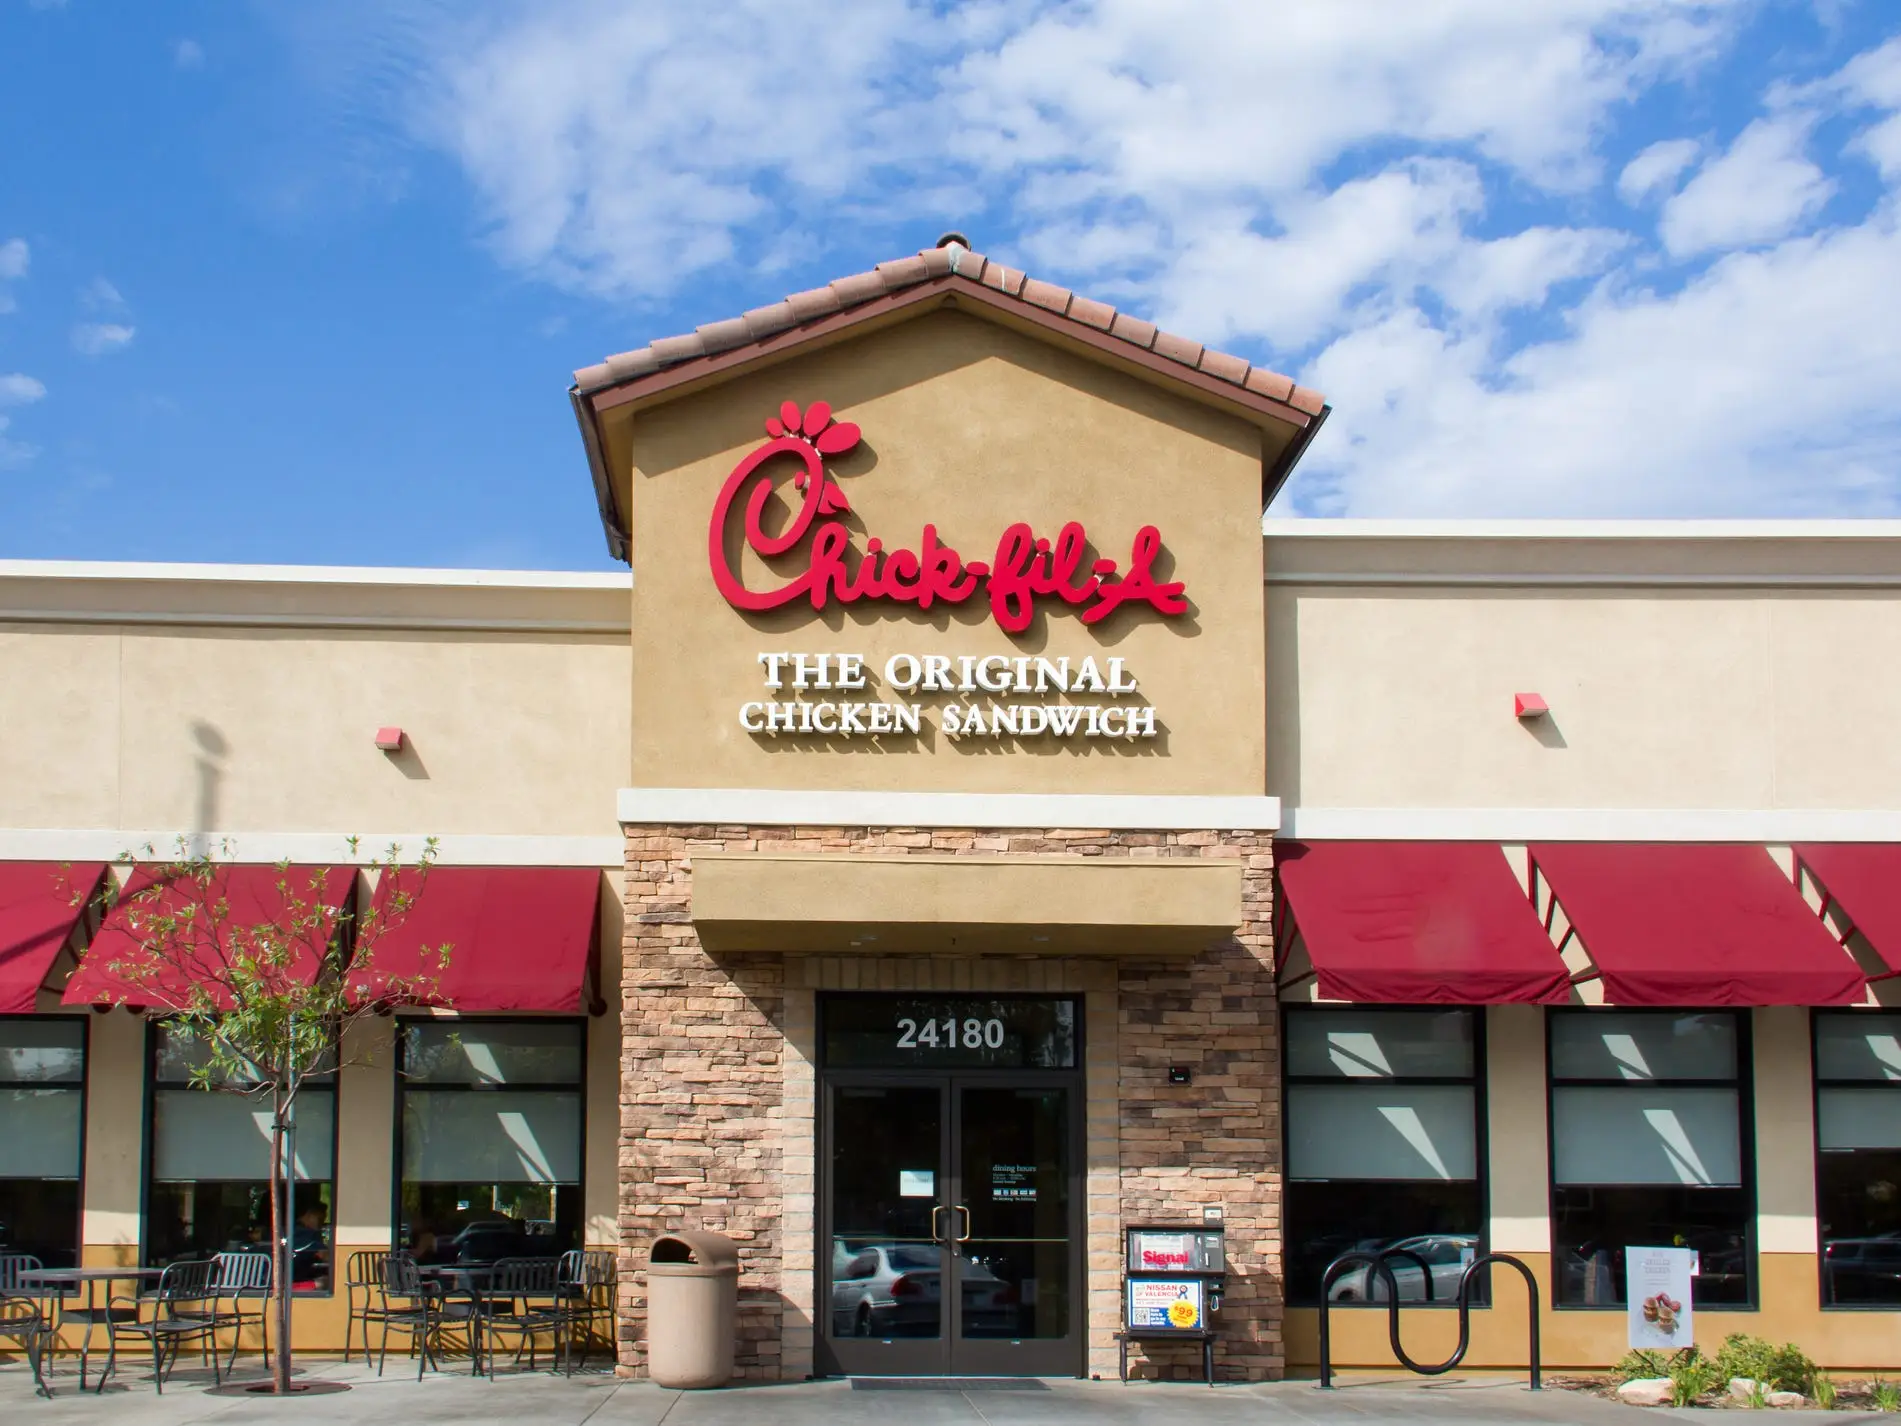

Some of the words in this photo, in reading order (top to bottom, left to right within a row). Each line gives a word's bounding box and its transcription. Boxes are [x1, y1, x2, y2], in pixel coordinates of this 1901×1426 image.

[708, 437, 1188, 633] Chick-fil-A
[758, 651, 866, 689] THE
[884, 653, 1138, 693] ORIGINAL
[738, 701, 921, 734] CHICKEN
[942, 704, 1157, 737] SANDWICH
[896, 1018, 1004, 1048] 24180
[1142, 1250, 1190, 1266] Signal
